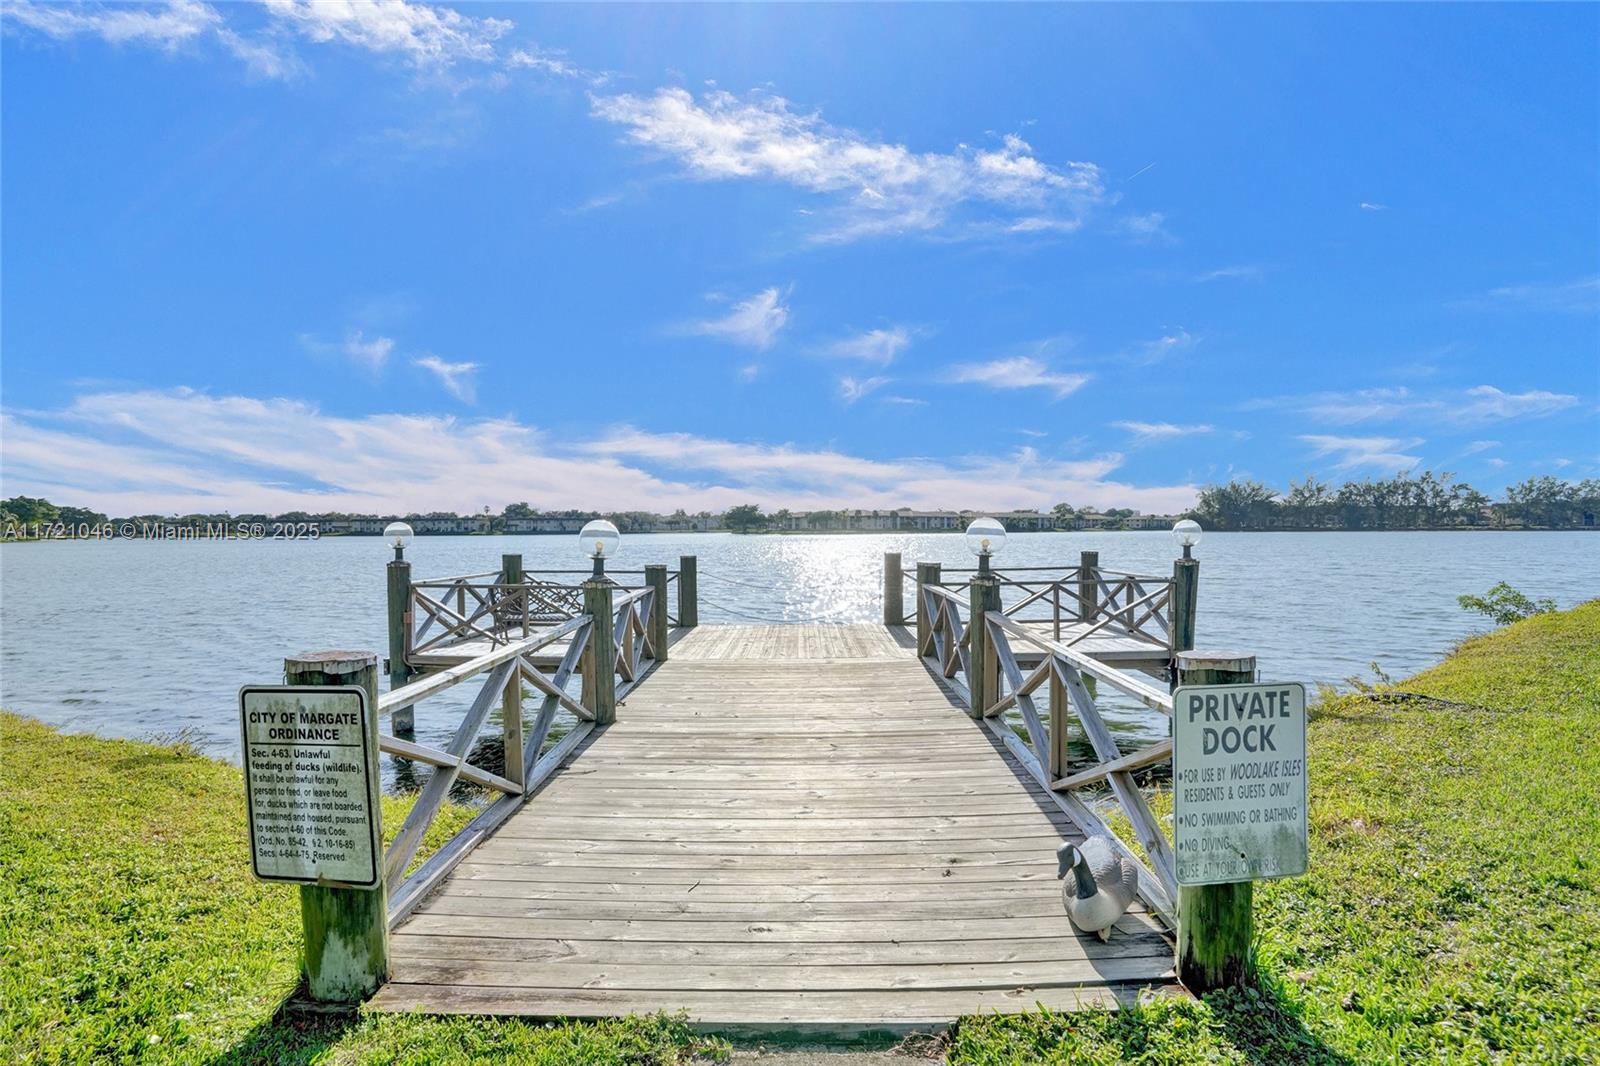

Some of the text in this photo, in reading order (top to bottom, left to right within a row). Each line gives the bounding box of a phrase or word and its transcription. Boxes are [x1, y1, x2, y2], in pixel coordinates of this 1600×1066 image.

[1189, 690, 1290, 722] PRIVATE
[250, 712, 358, 725] CITY OF MARGATE
[269, 728, 339, 740] ORDINANCE
[1203, 724, 1276, 755] DOCK
[251, 749, 330, 759] Sec. 4-63. Unlawful
[252, 762, 362, 774] feeding of ducks (wildlife).
[1184, 760, 1301, 783] FOR USE BY WOODLAKE ISLES
[276, 775, 284, 783] be
[285, 775, 314, 784] unlawful
[315, 776, 324, 785] for
[326, 777, 339, 786] any
[254, 788, 276, 796] person
[313, 789, 330, 797] leave
[332, 789, 347, 797] food
[1184, 782, 1291, 803] RESIDENTS & GUESTS ONLY
[267, 800, 287, 808] ducks
[288, 801, 308, 809] which
[322, 802, 333, 810] not
[256, 812, 292, 820] maintained
[293, 813, 305, 821] and
[336, 815, 366, 824] pursuant
[1184, 807, 1297, 828] NO SWIMMING OR BATHING
[265, 825, 289, 833] section
[290, 825, 304, 833] 4-60
[306, 826, 313, 834] of
[314, 826, 326, 835] this
[328, 826, 348, 836] Code.
[1184, 836, 1229, 852] NO DIVING
[1203, 862, 1212, 876] AT
